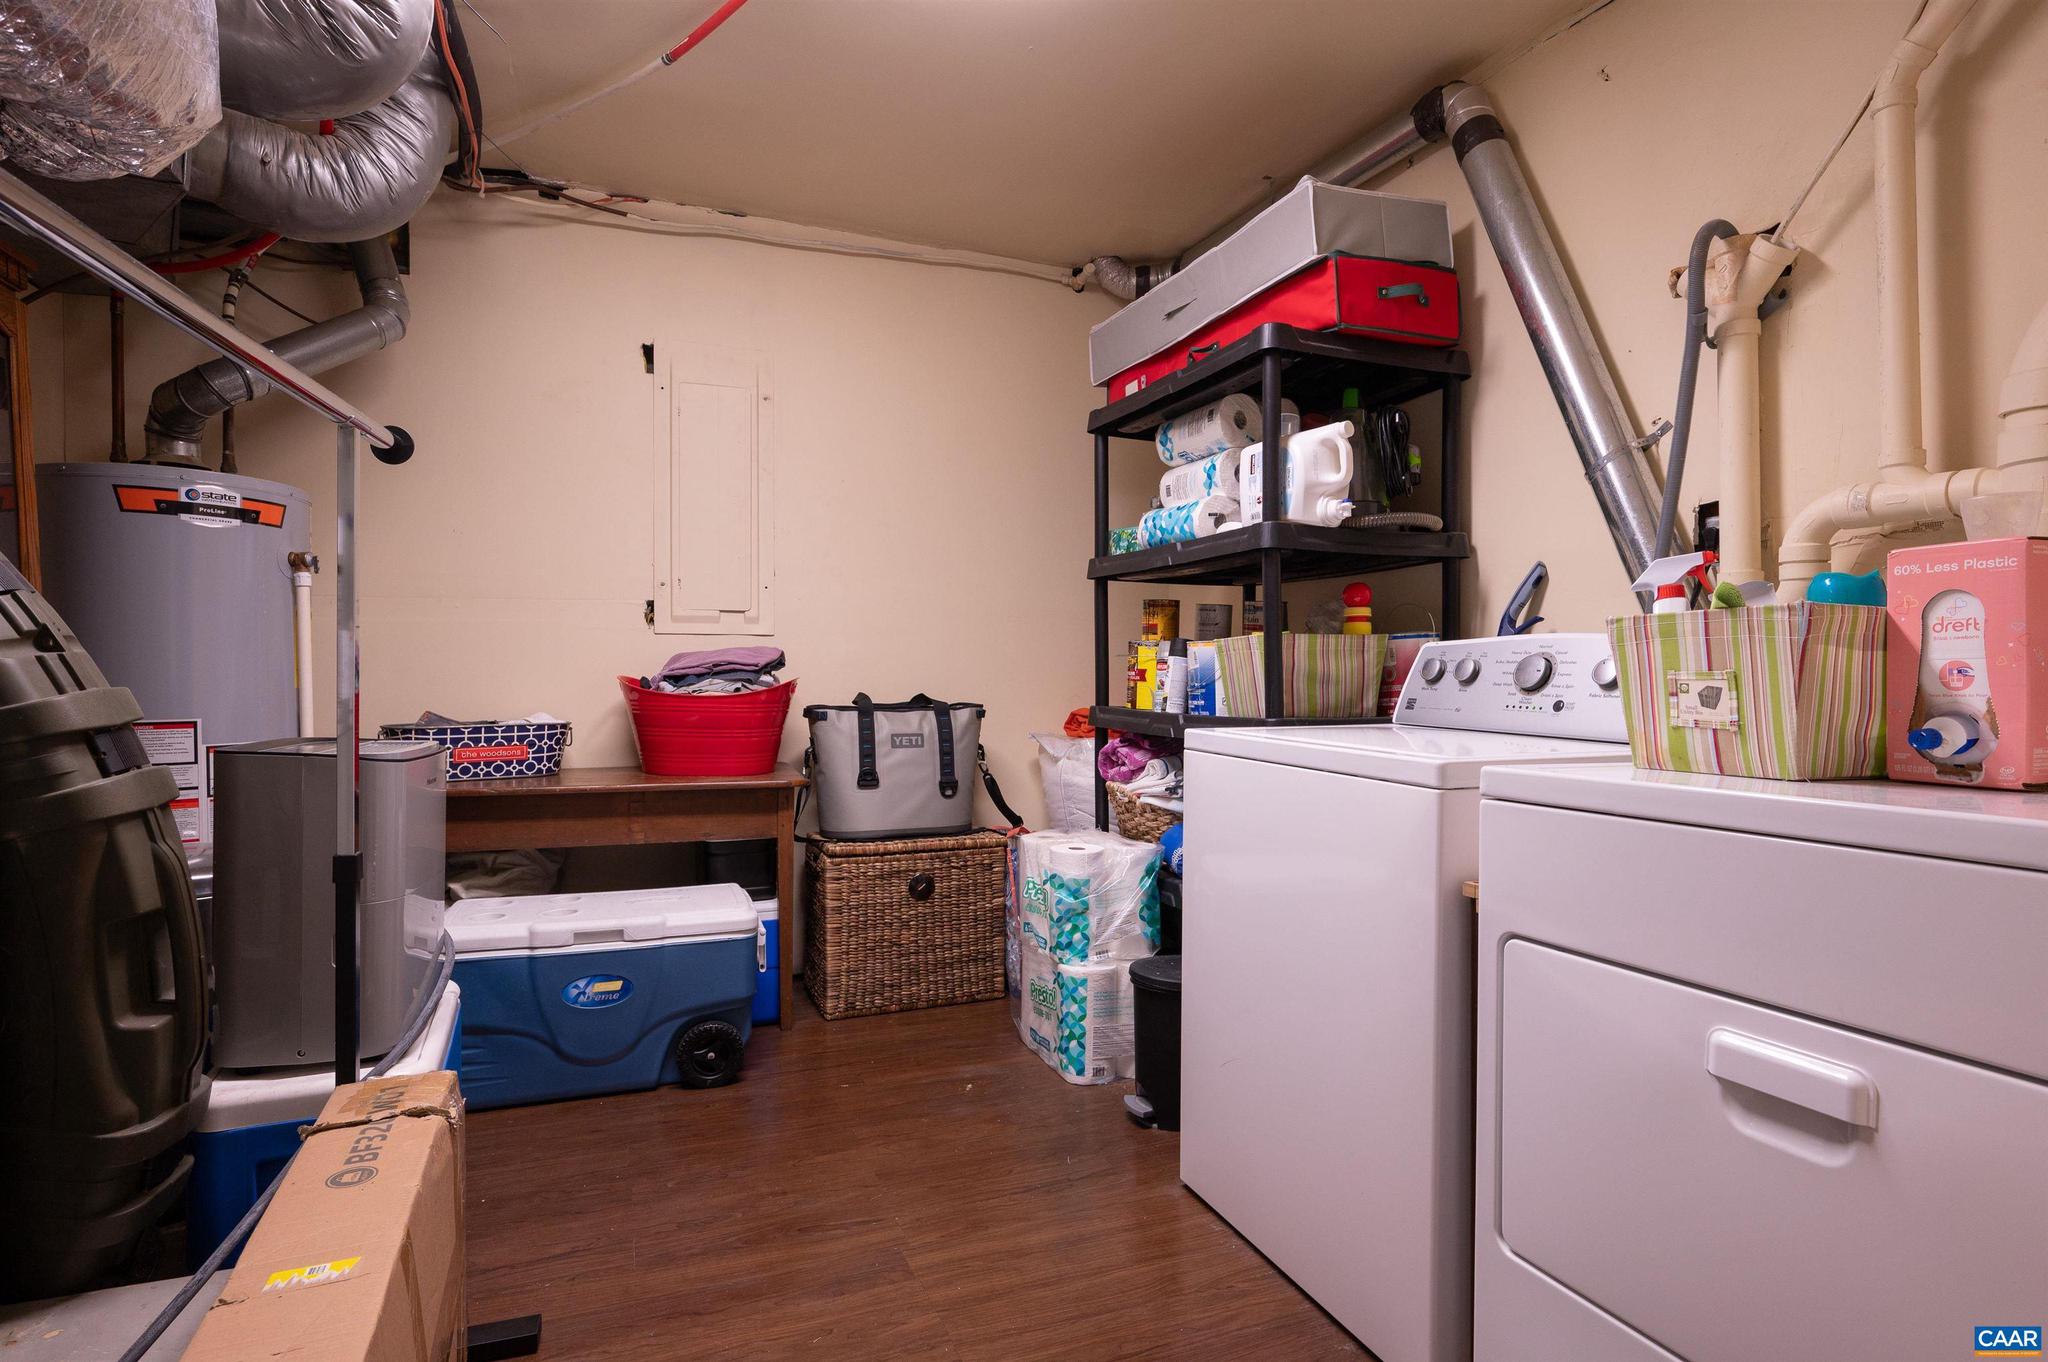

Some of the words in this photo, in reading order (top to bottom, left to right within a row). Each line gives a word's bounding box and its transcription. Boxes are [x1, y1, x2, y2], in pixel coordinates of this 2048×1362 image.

[201, 491, 237, 502] state
[1894, 564, 1922, 576] 60%
[1926, 562, 1959, 574] Less
[1964, 556, 2018, 570] Plastic
[1932, 616, 1981, 633] dreft
[893, 736, 922, 745] YETI
[461, 750, 477, 758] the
[479, 749, 521, 758] woodsons
[1030, 979, 1057, 1011] Presto!
